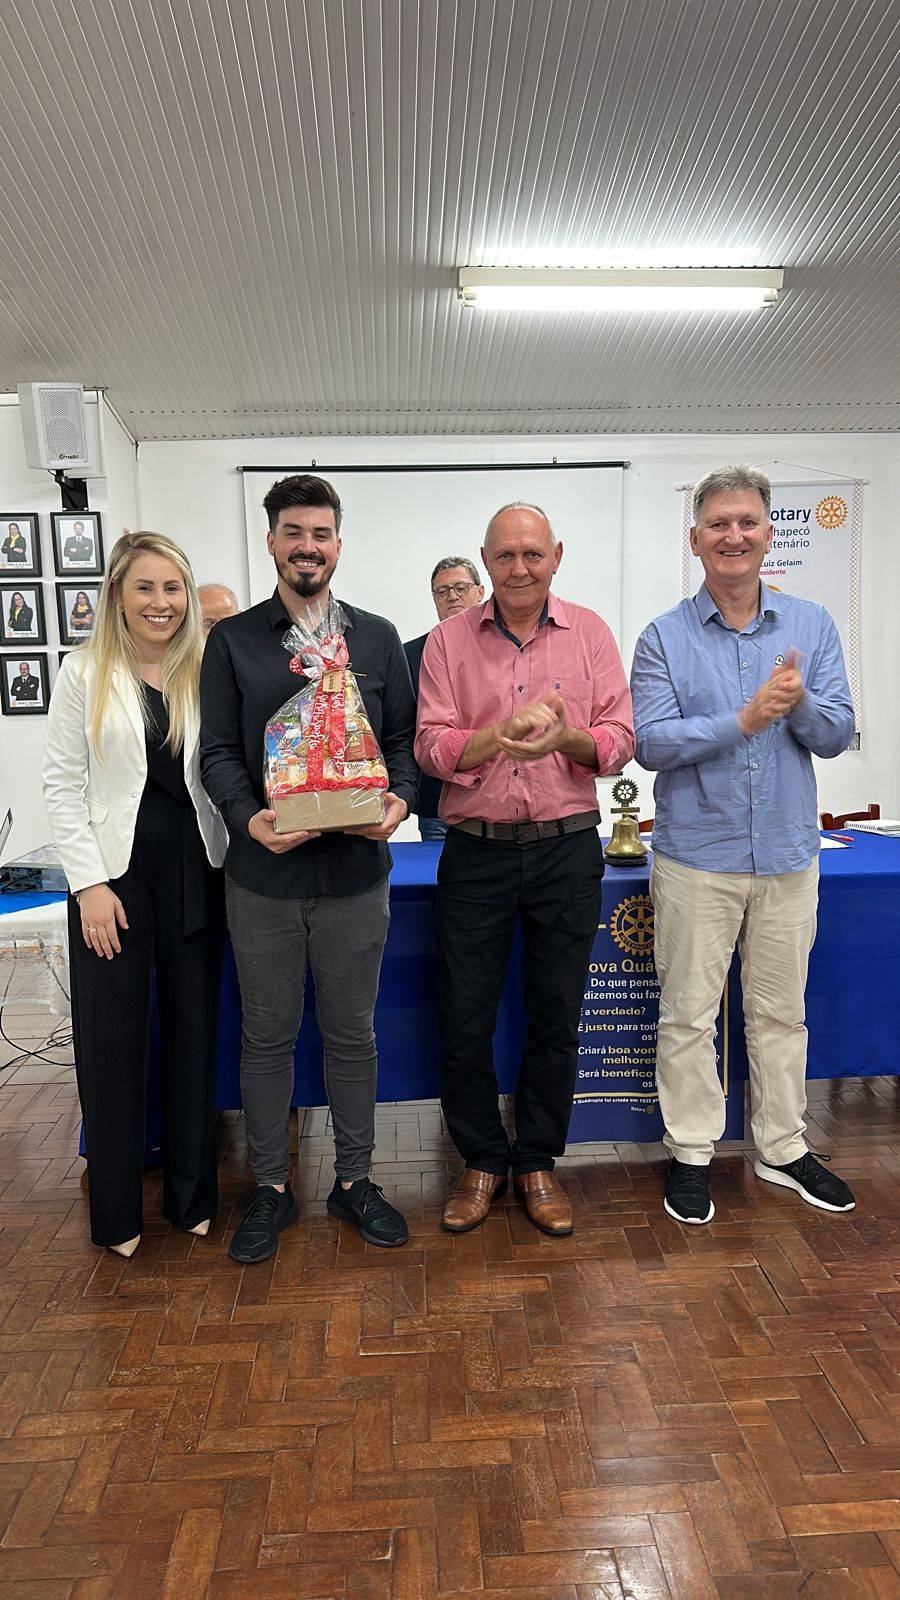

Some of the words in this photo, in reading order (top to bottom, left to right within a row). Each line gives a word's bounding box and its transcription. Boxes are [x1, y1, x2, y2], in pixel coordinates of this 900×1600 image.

[770, 508, 811, 523] otary
[773, 526, 810, 538] hapecó
[771, 539, 810, 549] tenário
[777, 559, 802, 567] Gelaim
[620, 934, 654, 950] INTERNATIO
[589, 962, 617, 973] ova
[591, 978, 606, 987] Do
[607, 979, 627, 989] que
[629, 979, 660, 988] pensa
[583, 990, 628, 1000] dizemos
[592, 1006, 646, 1016] verdade?
[584, 1022, 615, 1033] justo
[616, 1023, 638, 1033] para
[640, 1022, 659, 1031] tod
[578, 1045, 606, 1055] Criará
[608, 1046, 630, 1054] boa
[602, 1055, 657, 1064] melhores
[578, 1068, 600, 1078] Será
[601, 1069, 653, 1078] benéfico
